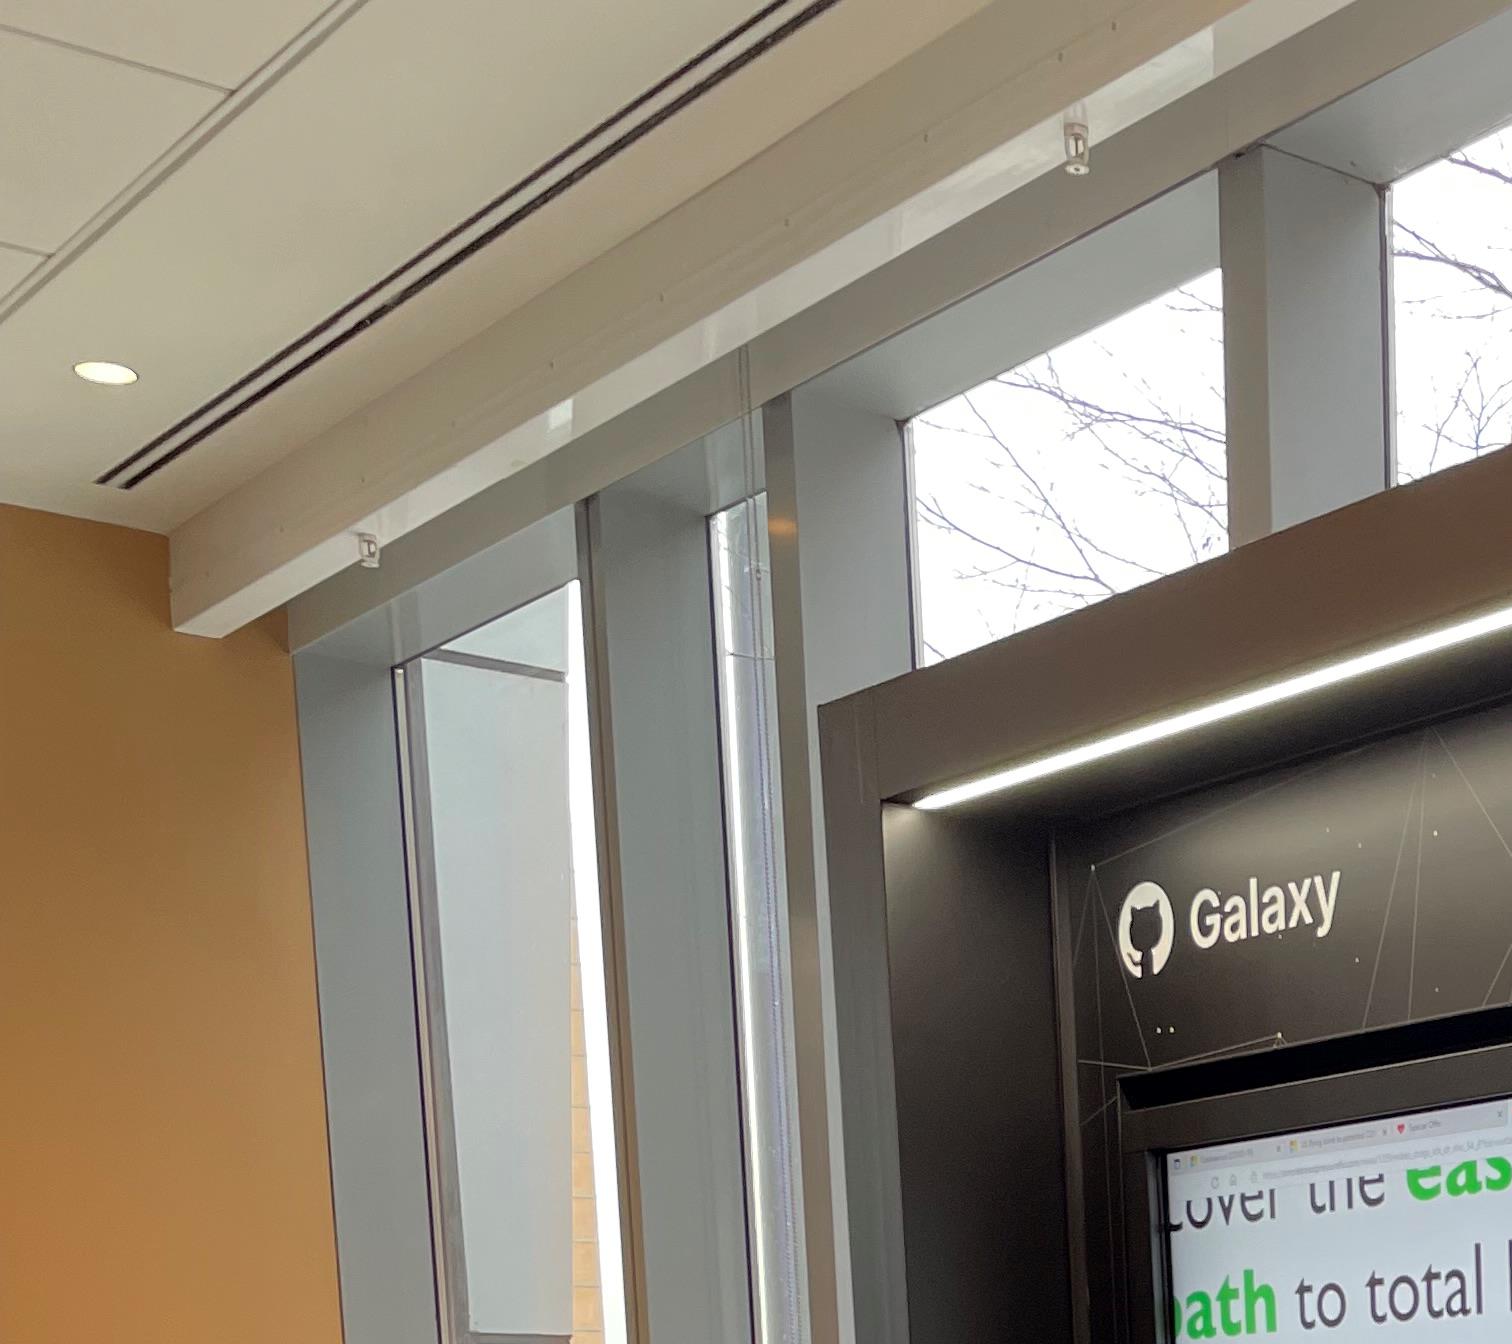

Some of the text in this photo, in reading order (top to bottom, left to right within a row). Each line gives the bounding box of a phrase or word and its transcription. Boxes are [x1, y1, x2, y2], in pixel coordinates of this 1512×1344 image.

[1190, 870, 1341, 951] Galaxy
[1174, 1269, 1277, 1340] ath
[1295, 1278, 1346, 1330] to
[1365, 1242, 1485, 1326] total
